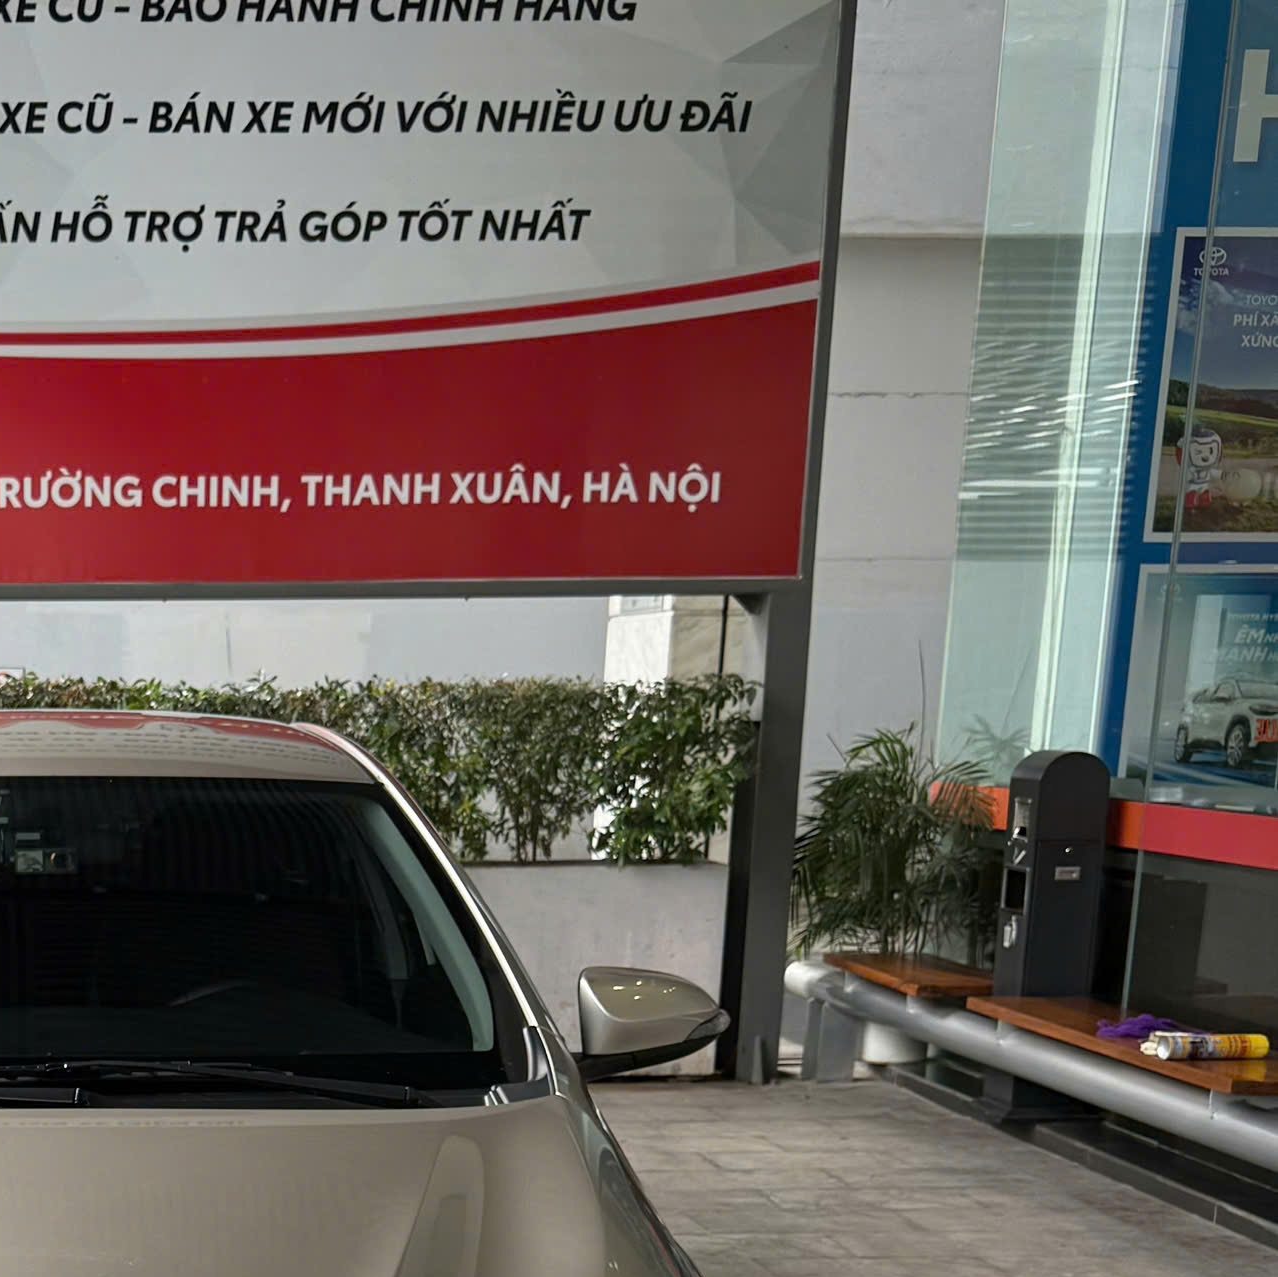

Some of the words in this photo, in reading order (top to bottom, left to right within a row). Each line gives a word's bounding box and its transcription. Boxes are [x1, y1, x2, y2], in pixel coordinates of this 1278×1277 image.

[57, 93, 114, 133] CŨ
[148, 92, 234, 133] BÁN
[242, 101, 293, 133] XE
[302, 92, 385, 133] MỚI
[397, 92, 467, 133] VỚI
[476, 89, 603, 132] NHIỀU
[614, 95, 672, 132] ƯU
[680, 92, 752, 133] ĐÃI
[50, 195, 113, 243] HỖ
[125, 204, 205, 252] TRỢ
[214, 200, 288, 243] TRẢ
[299, 201, 387, 242] GÓP
[398, 199, 472, 241] TỐT
[479, 198, 590, 241] NHẤT
[1194, 267, 1229, 276] TOOTA
[152, 475, 291, 513] CHINH,
[300, 472, 440, 507] THANH
[449, 464, 572, 509] XUÂN,
[583, 463, 638, 503] HÀ
[648, 463, 721, 513] NỘI
